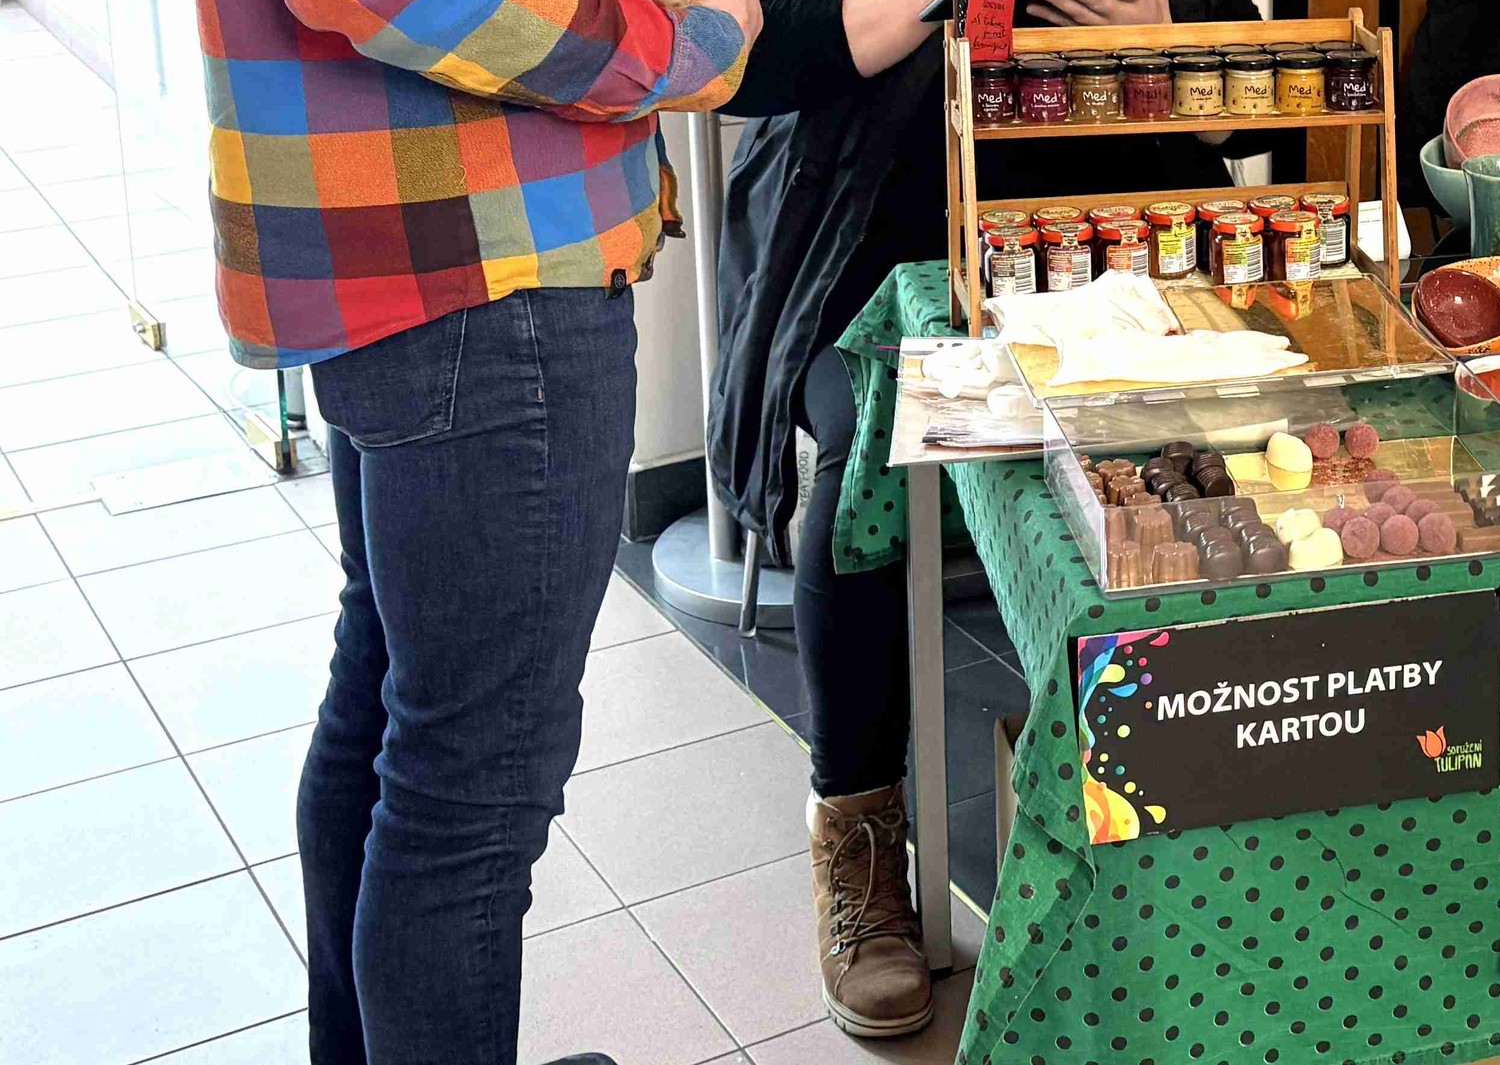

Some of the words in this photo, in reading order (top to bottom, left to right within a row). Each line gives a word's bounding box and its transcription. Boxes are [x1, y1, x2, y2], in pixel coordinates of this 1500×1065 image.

[1157, 676, 1320, 721] MOŽNOST
[1327, 660, 1443, 698] PLATBY
[1236, 709, 1366, 749] KARTOU
[1434, 753, 1483, 773] TULIPAN
